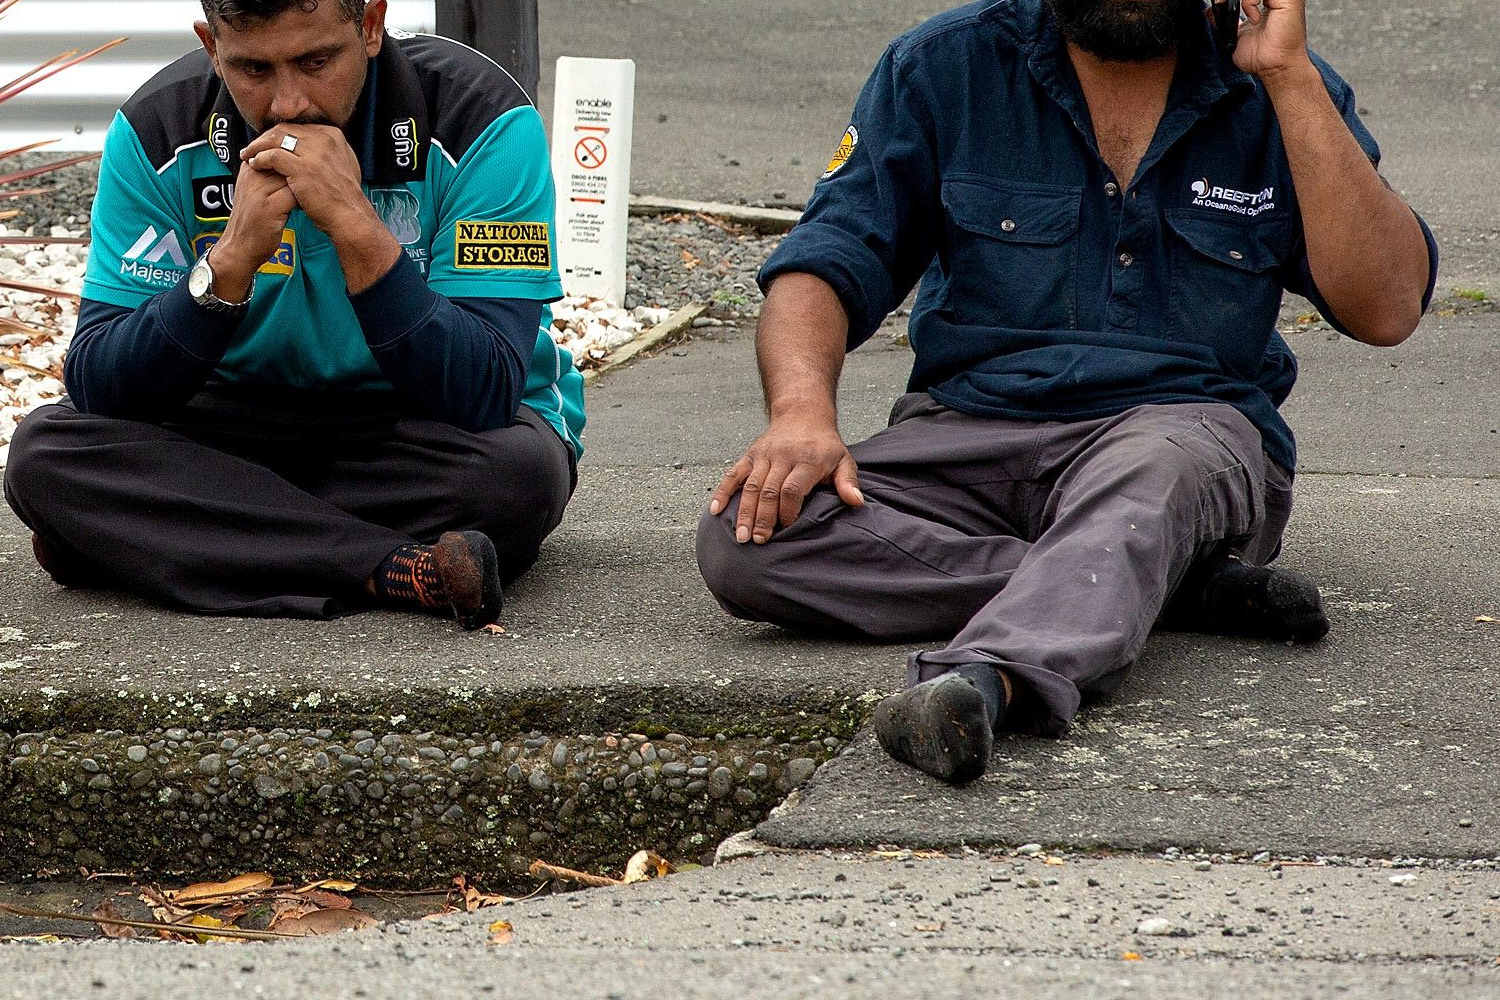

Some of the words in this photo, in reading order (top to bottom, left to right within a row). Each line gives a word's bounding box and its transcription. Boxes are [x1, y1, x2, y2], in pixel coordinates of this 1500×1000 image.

[575, 98, 612, 108] enable
[211, 117, 230, 163] cua
[390, 119, 414, 167] cua
[1192, 198, 1204, 207] An
[459, 224, 547, 241] NATIONAL
[463, 246, 546, 263] STORAGE
